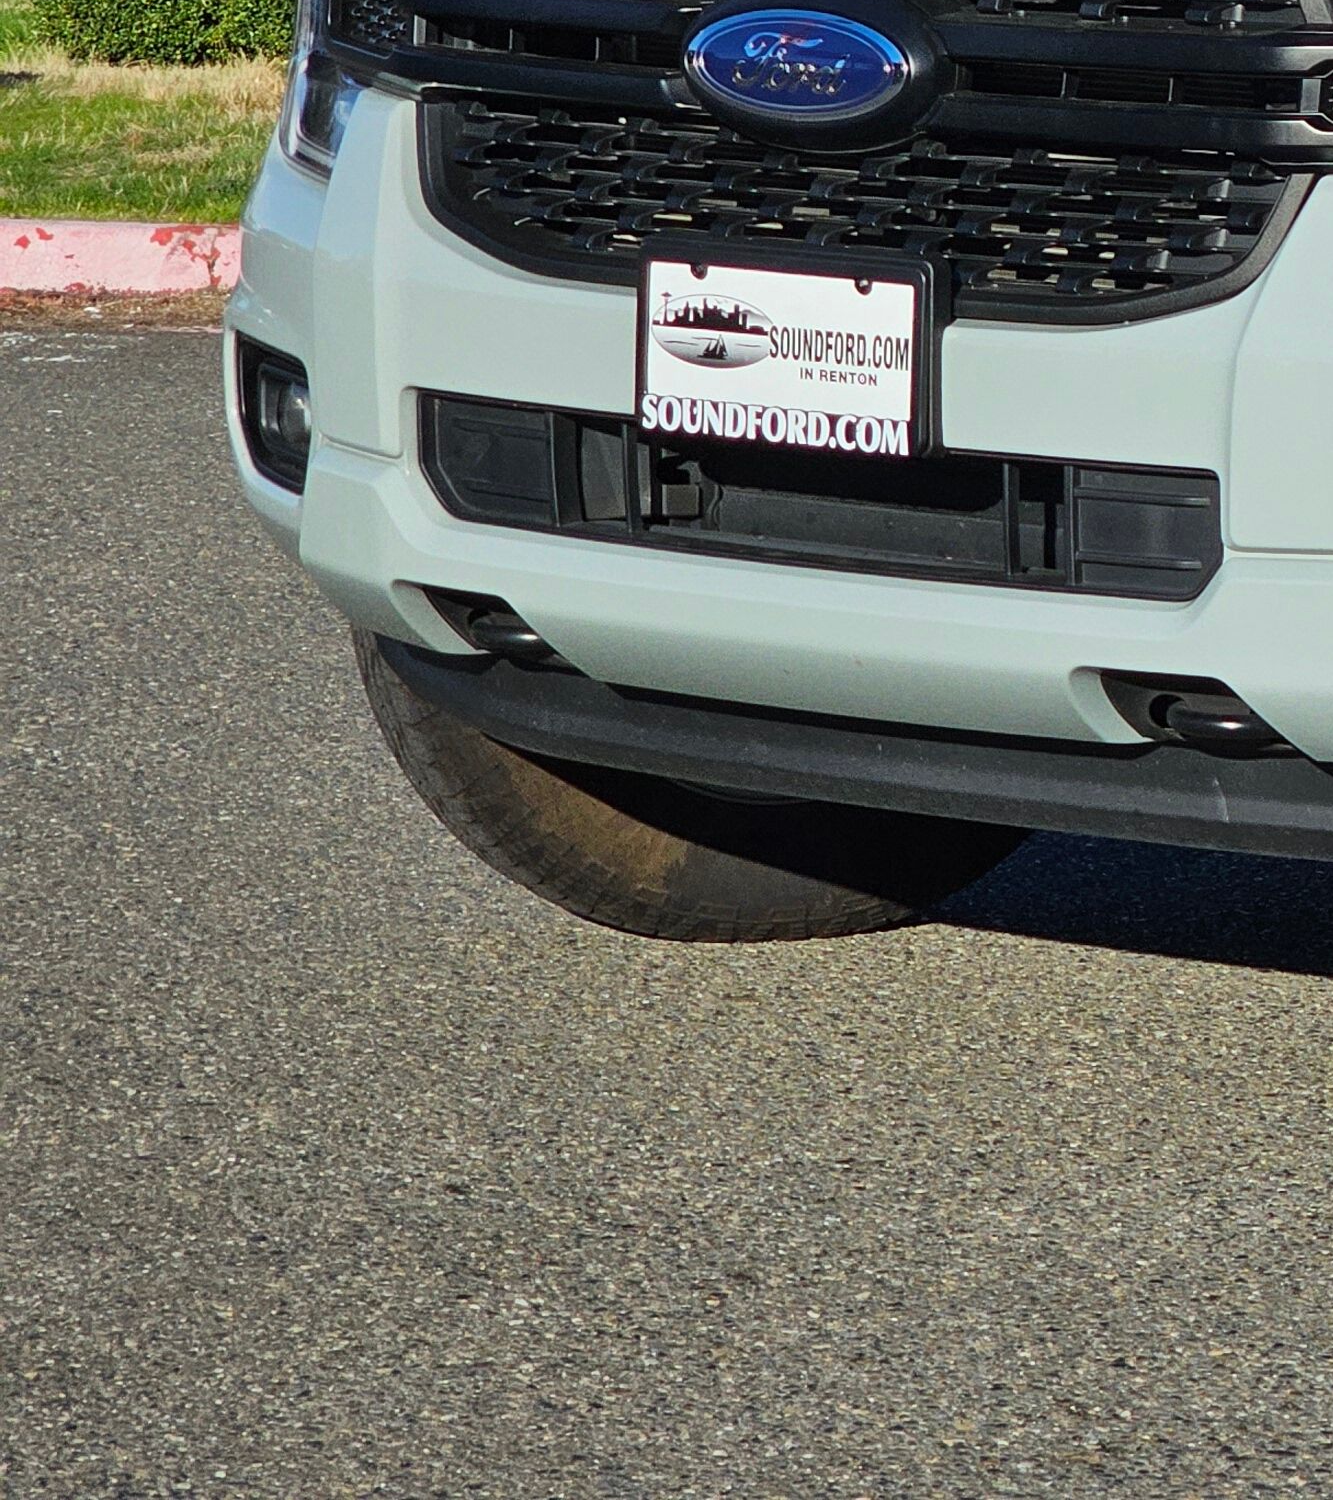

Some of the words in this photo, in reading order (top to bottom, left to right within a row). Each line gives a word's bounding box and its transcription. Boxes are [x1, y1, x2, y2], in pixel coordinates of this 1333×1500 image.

[731, 31, 850, 96] Ford
[769, 325, 910, 372] SOUNDFORD.COM
[800, 367, 814, 380] IN
[819, 370, 878, 386] RENTON
[641, 393, 910, 456] SOUNDFORD.COM
